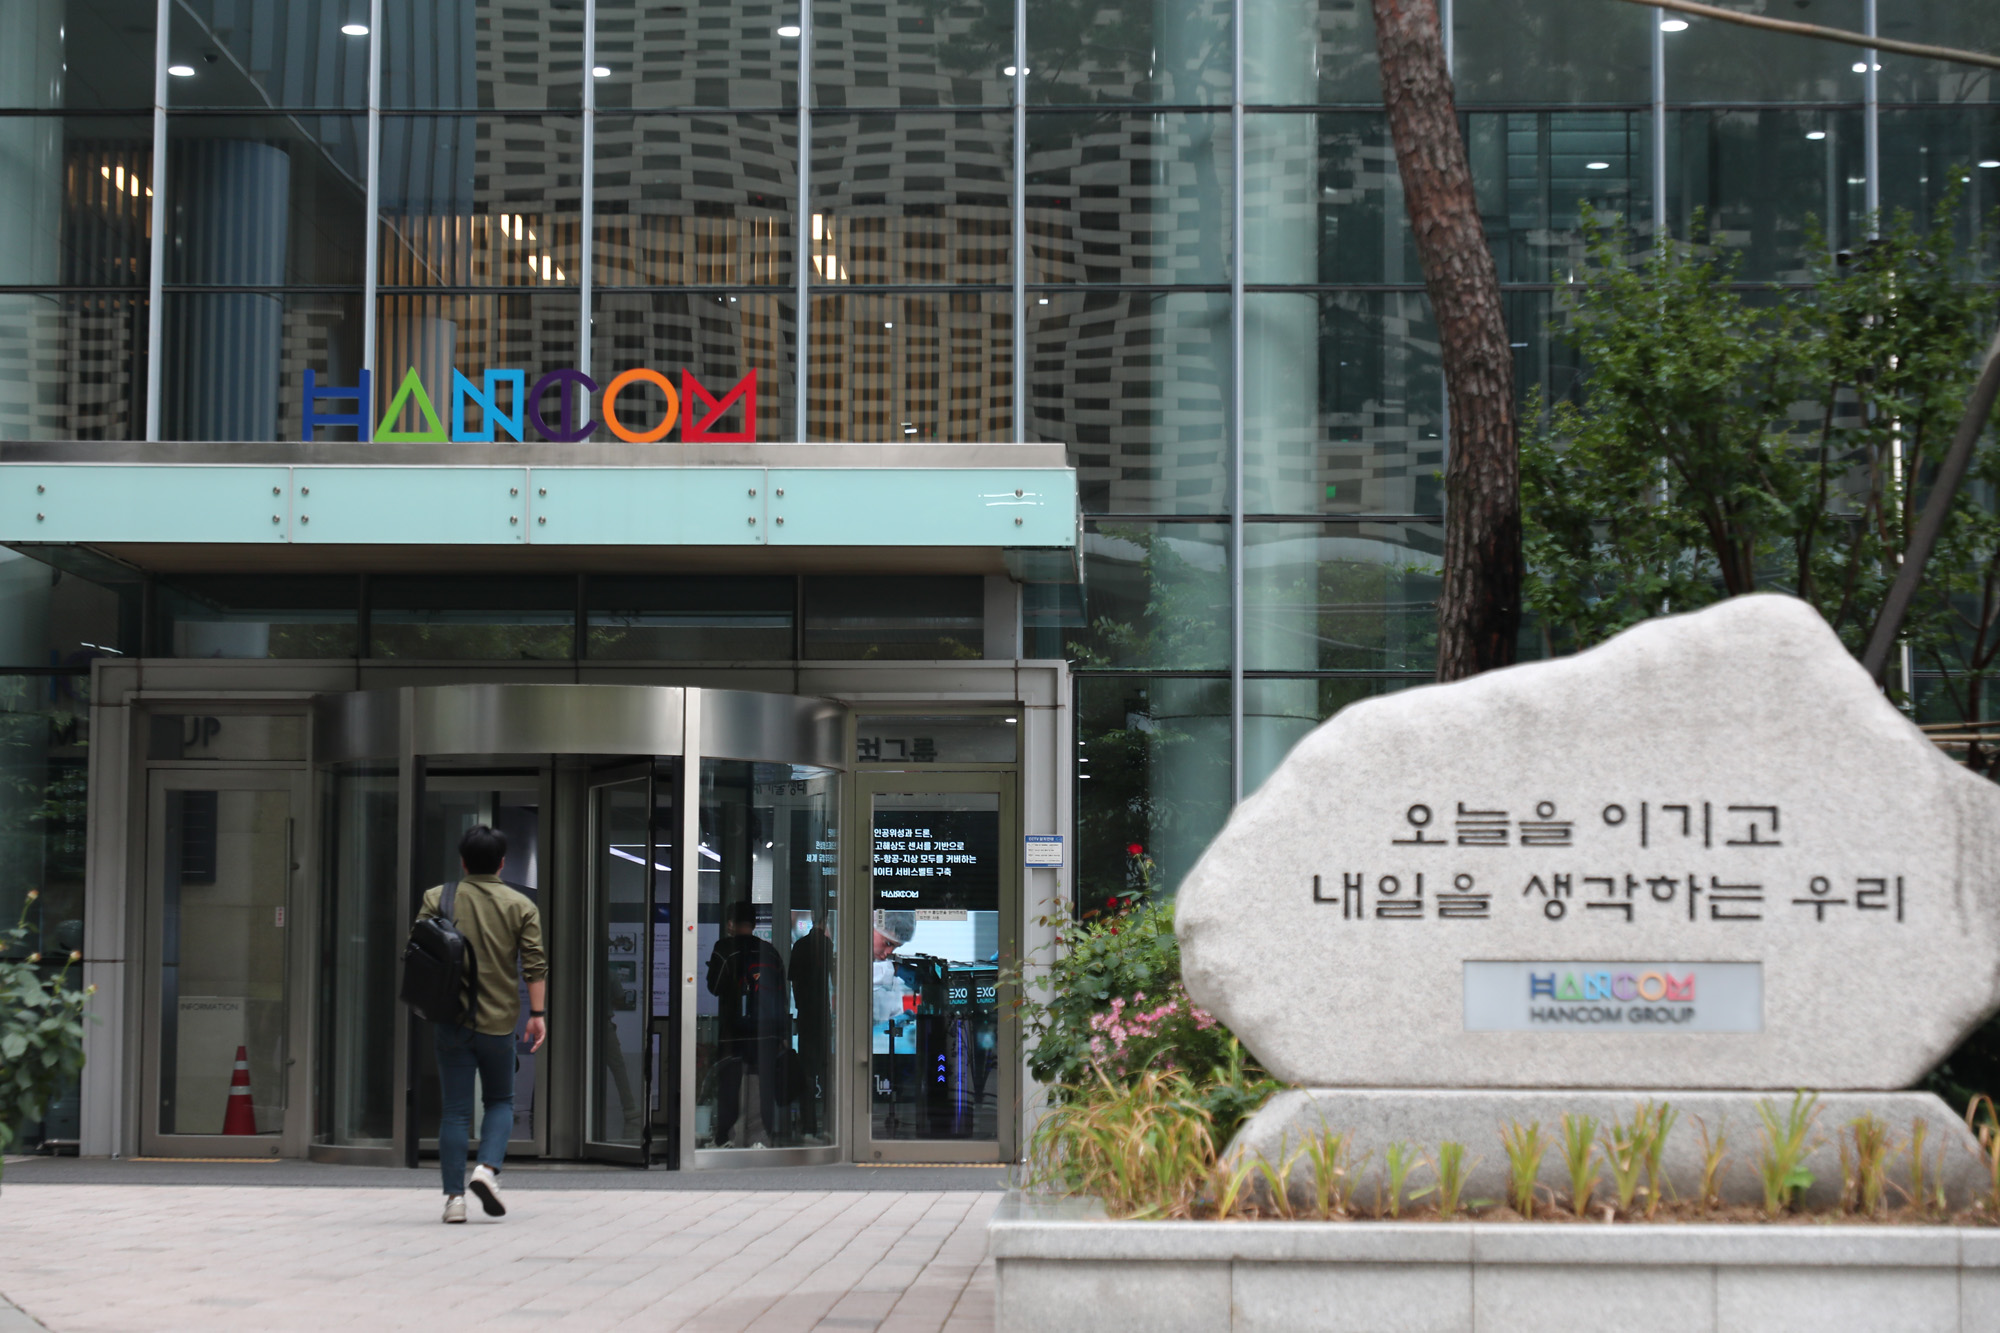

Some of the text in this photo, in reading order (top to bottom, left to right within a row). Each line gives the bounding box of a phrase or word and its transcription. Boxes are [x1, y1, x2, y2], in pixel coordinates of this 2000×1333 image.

[302, 366, 757, 443] HANCOM
[1391, 800, 1784, 849] 오늘을 이기고
[873, 828, 913, 838] 인공위성과
[874, 841, 965, 851] 고해상도 센서를 기반으로
[920, 854, 944, 864] 모두를
[945, 854, 977, 864] 커버하는
[1312, 872, 1905, 923] 내일을 생각하는 우리
[948, 988, 968, 999] EXO
[976, 987, 996, 997] EXO
[1530, 971, 1696, 1001] HANCOM
[1530, 1006, 1696, 1025] HANCOM GROUP
